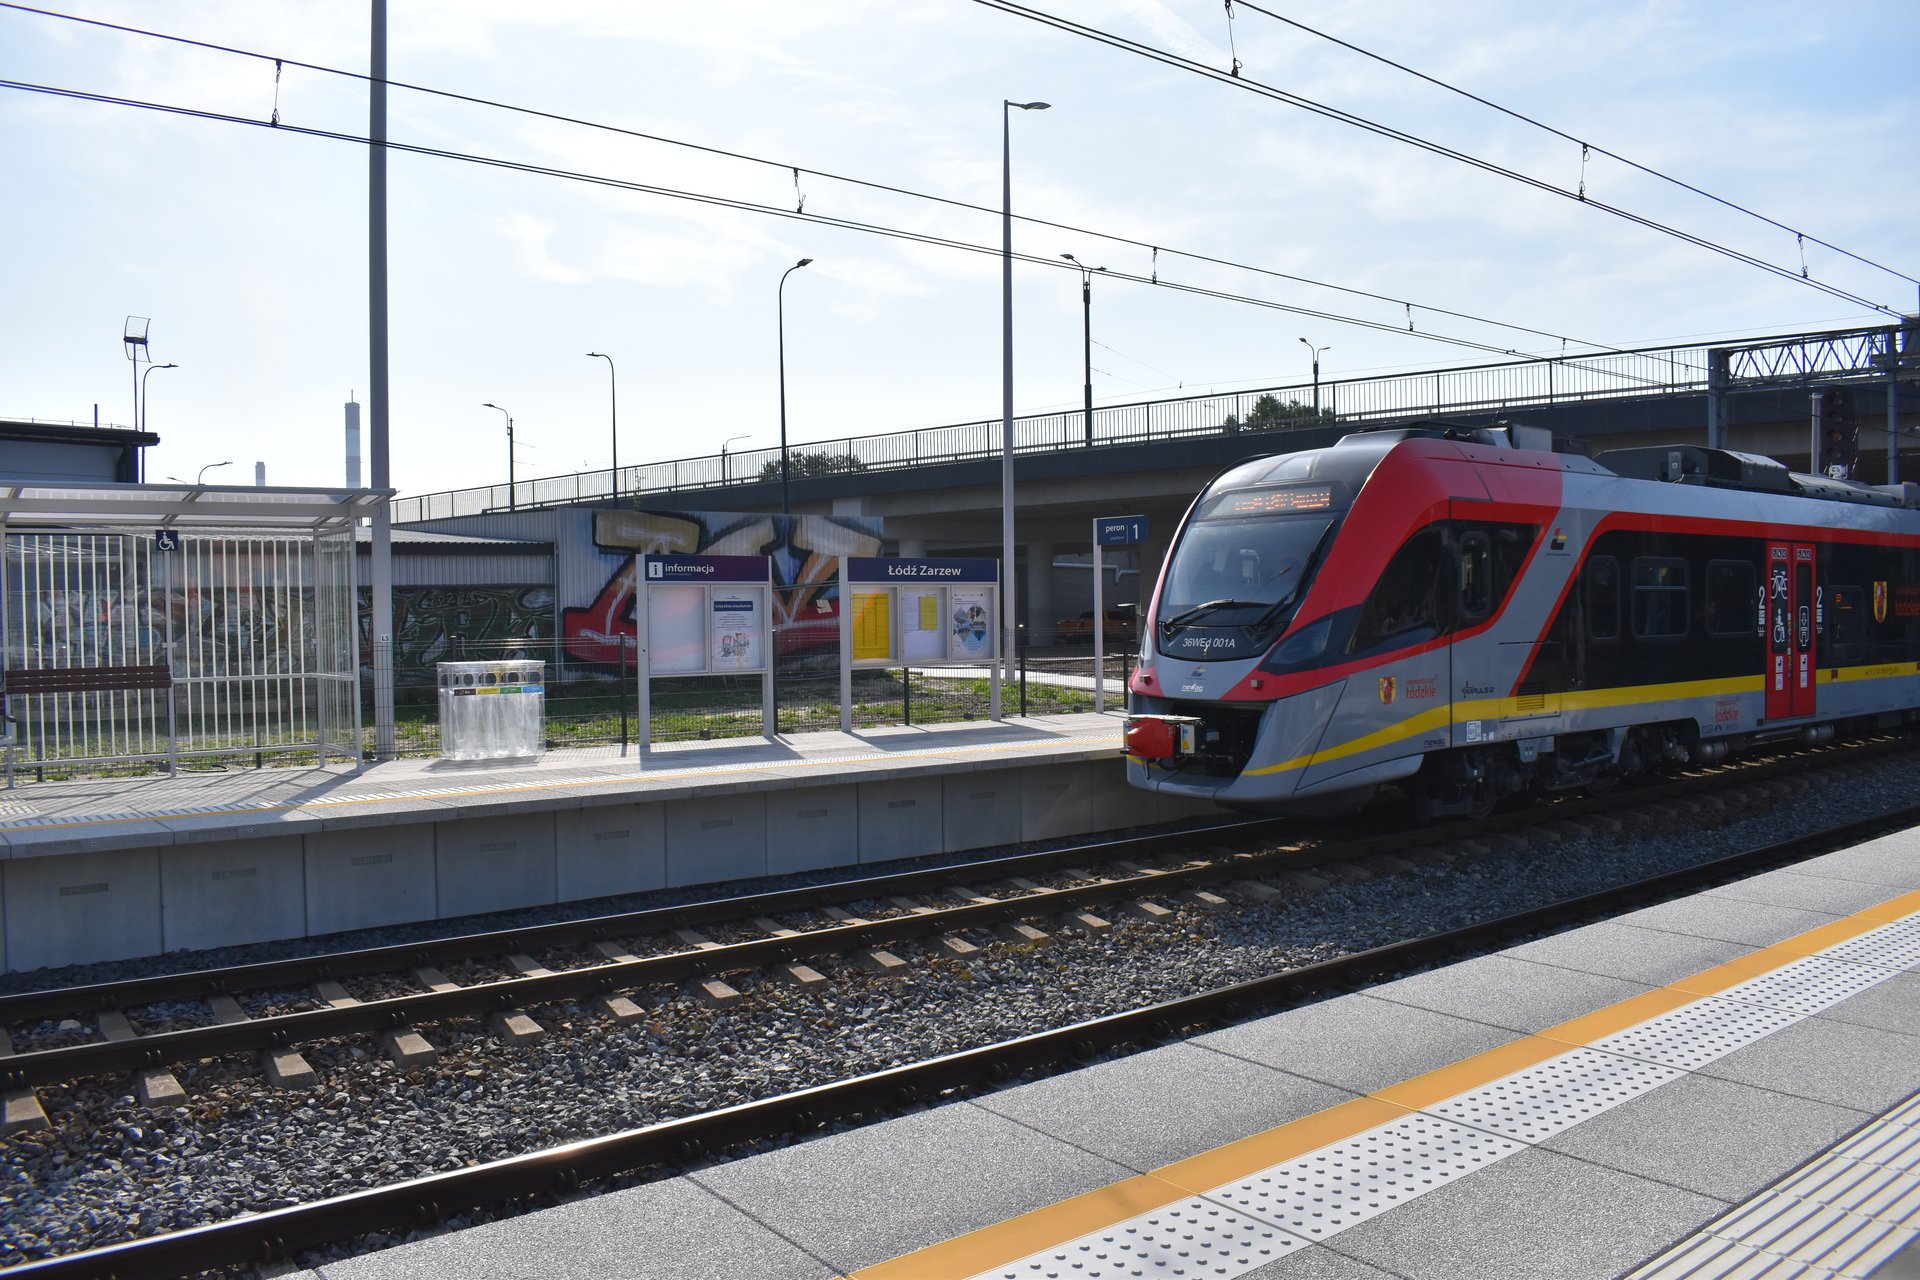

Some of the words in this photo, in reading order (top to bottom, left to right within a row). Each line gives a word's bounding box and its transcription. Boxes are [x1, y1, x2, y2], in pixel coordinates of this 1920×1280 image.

[1105, 525, 1125, 533] peron
[1133, 523, 1139, 540] 1
[665, 563, 714, 574] informacja
[888, 565, 917, 576] Łódź
[919, 565, 962, 576] Zarzew
[1758, 585, 1765, 609] 2
[1816, 585, 1823, 608] 2
[1182, 637, 1211, 648] 36WEd
[1212, 638, 1236, 648] 001A
[1406, 686, 1437, 699] łódzkie
